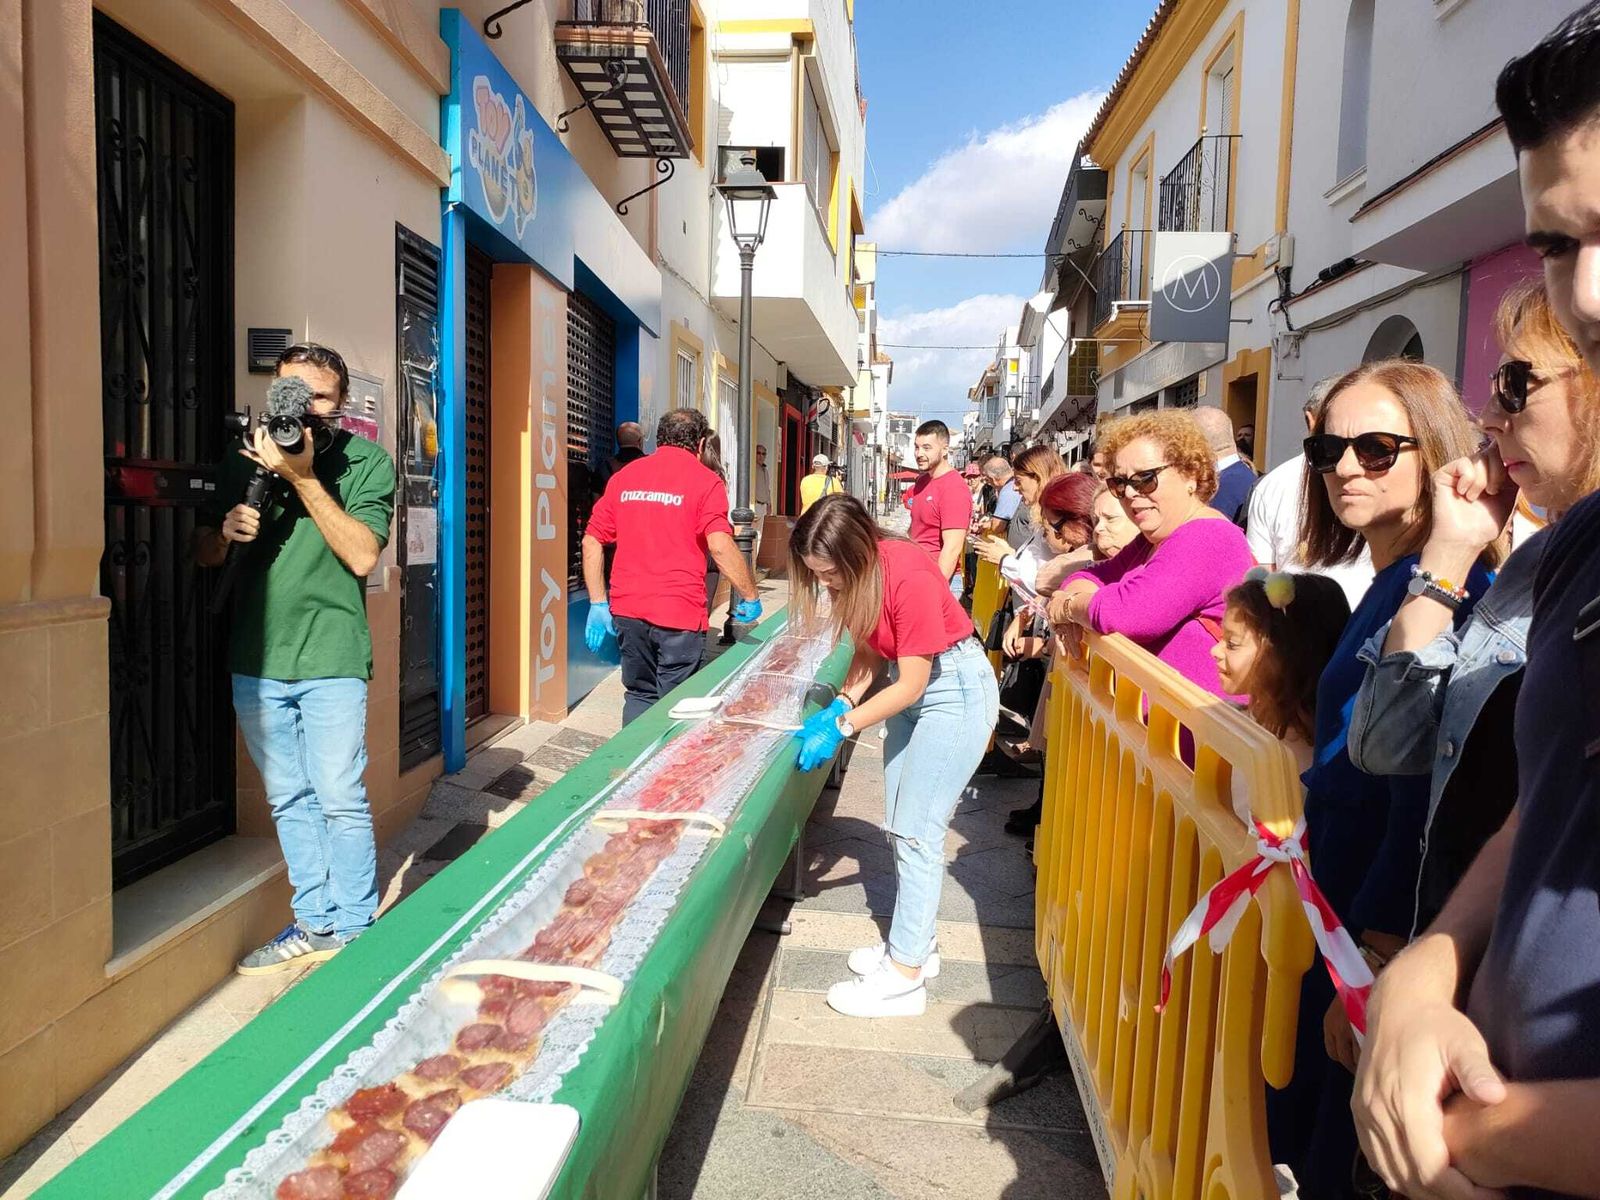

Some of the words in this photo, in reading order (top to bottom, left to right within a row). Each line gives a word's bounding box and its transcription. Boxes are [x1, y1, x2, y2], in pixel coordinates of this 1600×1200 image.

[471, 135, 517, 203] PLANET
[1172, 269, 1209, 299] M
[535, 568, 561, 700] Toy
